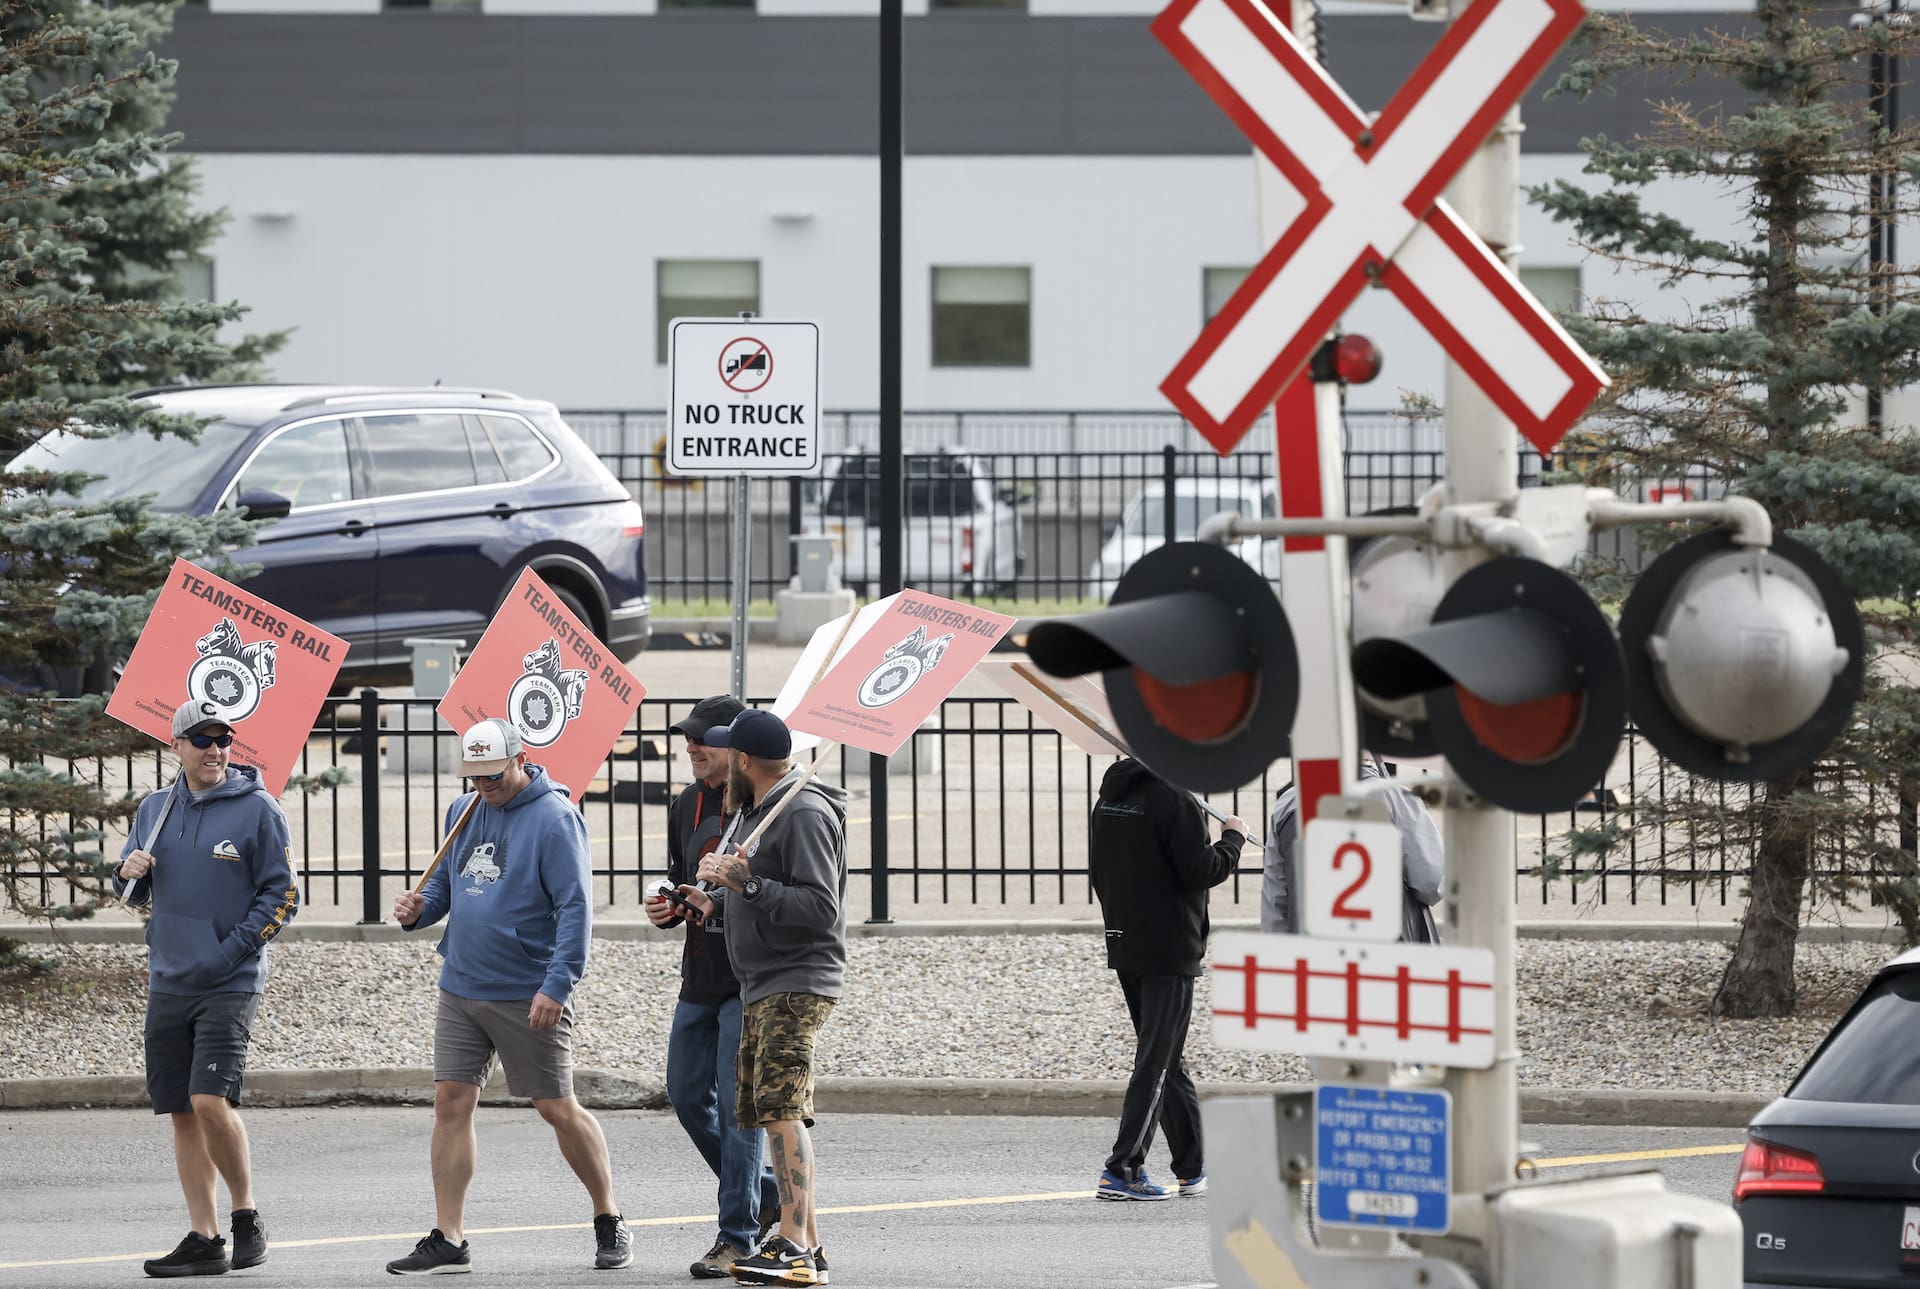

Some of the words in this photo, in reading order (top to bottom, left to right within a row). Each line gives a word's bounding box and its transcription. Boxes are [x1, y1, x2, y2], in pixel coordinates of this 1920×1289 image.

[686, 404, 720, 425] NO
[728, 404, 805, 425] TRUCK
[683, 437, 807, 457] ENTRANCE
[181, 572, 289, 639] TEAMSTERS
[290, 629, 331, 662] RAIL
[897, 598, 972, 631] TEAMSTERS
[969, 618, 1000, 639] RAIL
[522, 583, 601, 671] TEAMSTERS
[600, 664, 634, 705] RAIL
[210, 660, 252, 686] TEAMSTERS
[200, 702, 217, 716] C
[530, 680, 561, 713] TEAMSTERS
[518, 723, 531, 737] RAIL
[1331, 842, 1372, 919] 2
[1320, 1109, 1367, 1128] REPORT
[1372, 1114, 1445, 1134] EMERGENCY
[1333, 1130, 1350, 1147] OR
[1354, 1132, 1411, 1152] PROBLEM
[1415, 1136, 1432, 1153] TO
[1319, 1167, 1357, 1187] REFER
[1364, 1171, 1380, 1189] TO
[1385, 1174, 1448, 1194] CROSSING
[1757, 1233, 1786, 1250] Q5
